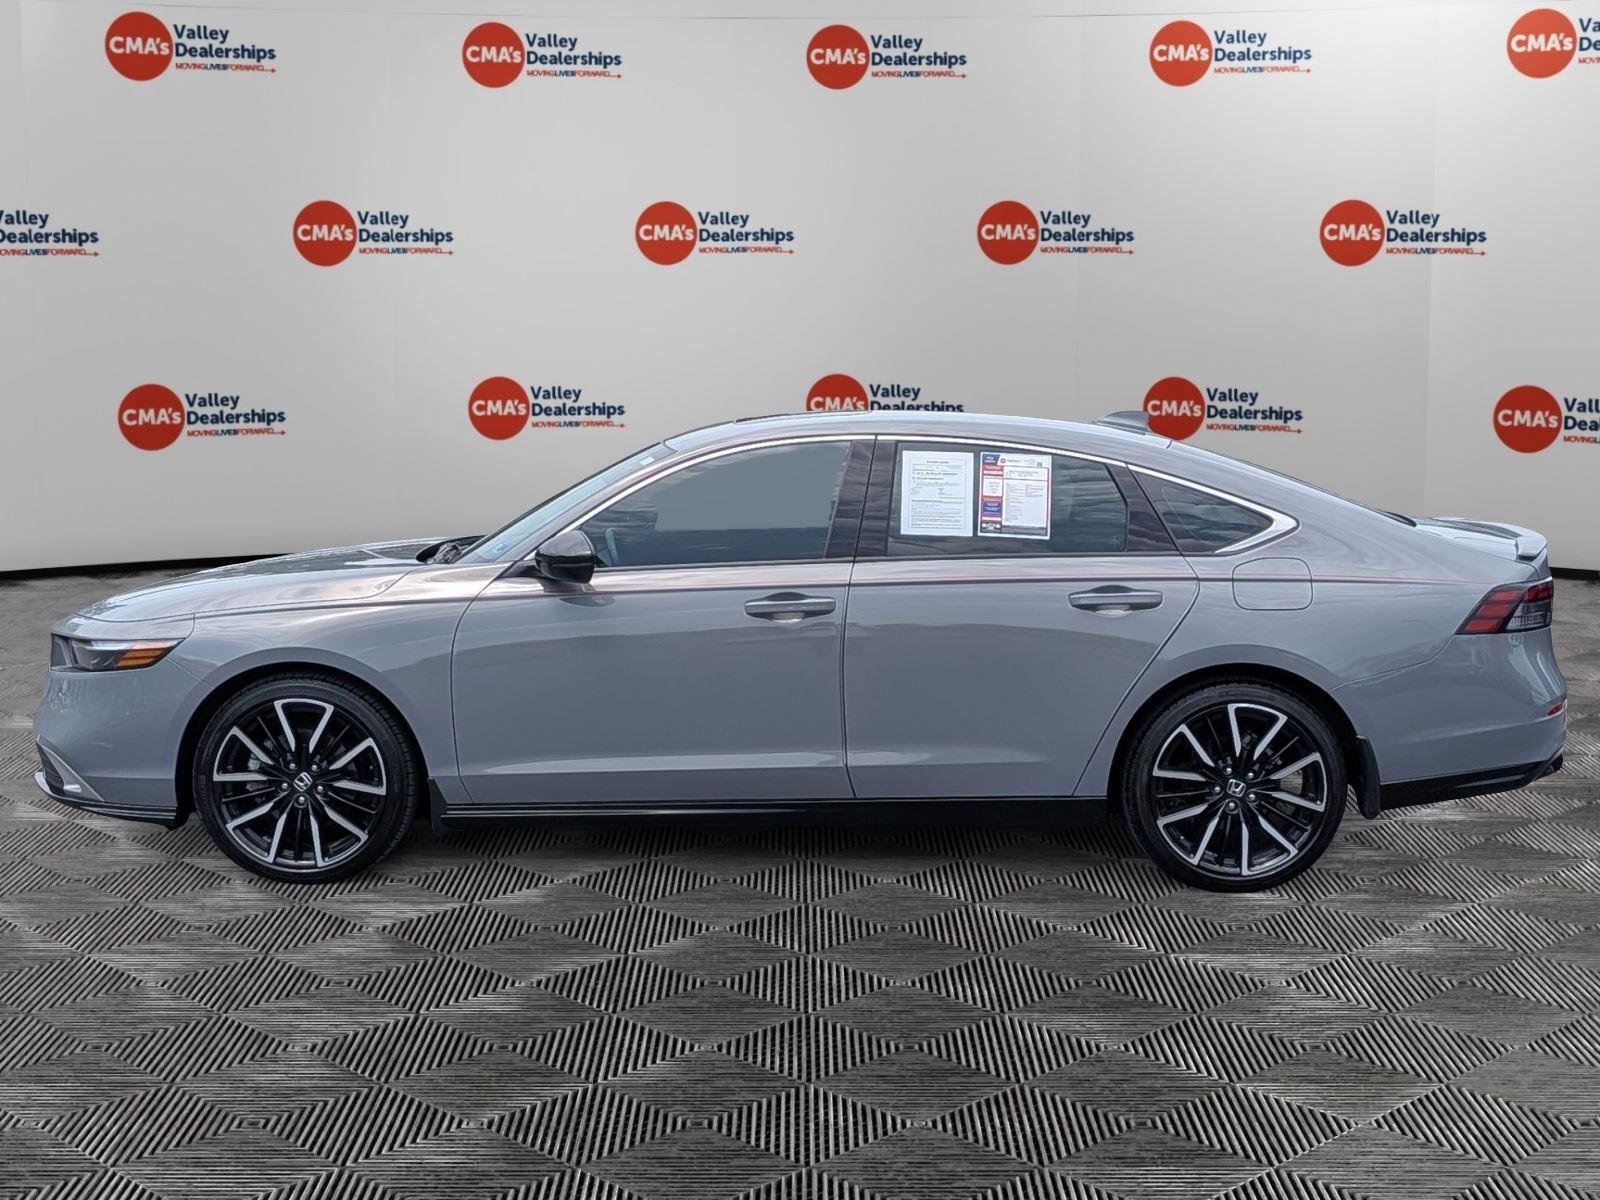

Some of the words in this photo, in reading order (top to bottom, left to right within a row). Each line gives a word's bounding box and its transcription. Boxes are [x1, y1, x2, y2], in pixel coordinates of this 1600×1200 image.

[174, 24, 229, 44] Valley
[525, 33, 578, 52] Valley
[870, 34, 923, 52] Valley
[1213, 29, 1267, 47] Valley
[1511, 32, 1574, 53] CMA's
[110, 36, 169, 56] CMA's
[174, 42, 277, 63] Dealerships
[466, 45, 522, 64] CMA's
[1153, 43, 1209, 62] CMA's
[1214, 46, 1312, 64] Dealerships
[526, 50, 623, 69] Dealerships
[810, 47, 866, 65] CMA's
[871, 51, 968, 69] Dealerships
[357, 210, 409, 229] Valley
[697, 211, 750, 229] Valley
[1040, 210, 1091, 229] Valley
[1386, 210, 1440, 228] Valley
[297, 224, 354, 242] CMA's
[358, 228, 454, 246] Dealerships
[640, 224, 695, 241] CMA's
[698, 227, 795, 245] Dealerships
[981, 223, 1036, 241] CMA's
[1040, 227, 1135, 246] Dealerships
[1324, 223, 1381, 241] CMA's
[1386, 227, 1487, 246] Dealerships
[185, 393, 240, 410] Valley
[530, 386, 582, 403] Valley
[869, 384, 921, 401] Valley
[1205, 387, 1259, 406] Valley
[473, 399, 527, 416] CMA's
[531, 402, 625, 419] Dealerships
[810, 396, 866, 411] CMA's
[1147, 400, 1202, 417] CMA's
[1563, 397, 1600, 413] Vall
[122, 408, 182, 426] CMA's
[186, 408, 286, 426] Dealerships
[1206, 404, 1303, 424] Dealerships
[1498, 409, 1558, 428] CMA's
